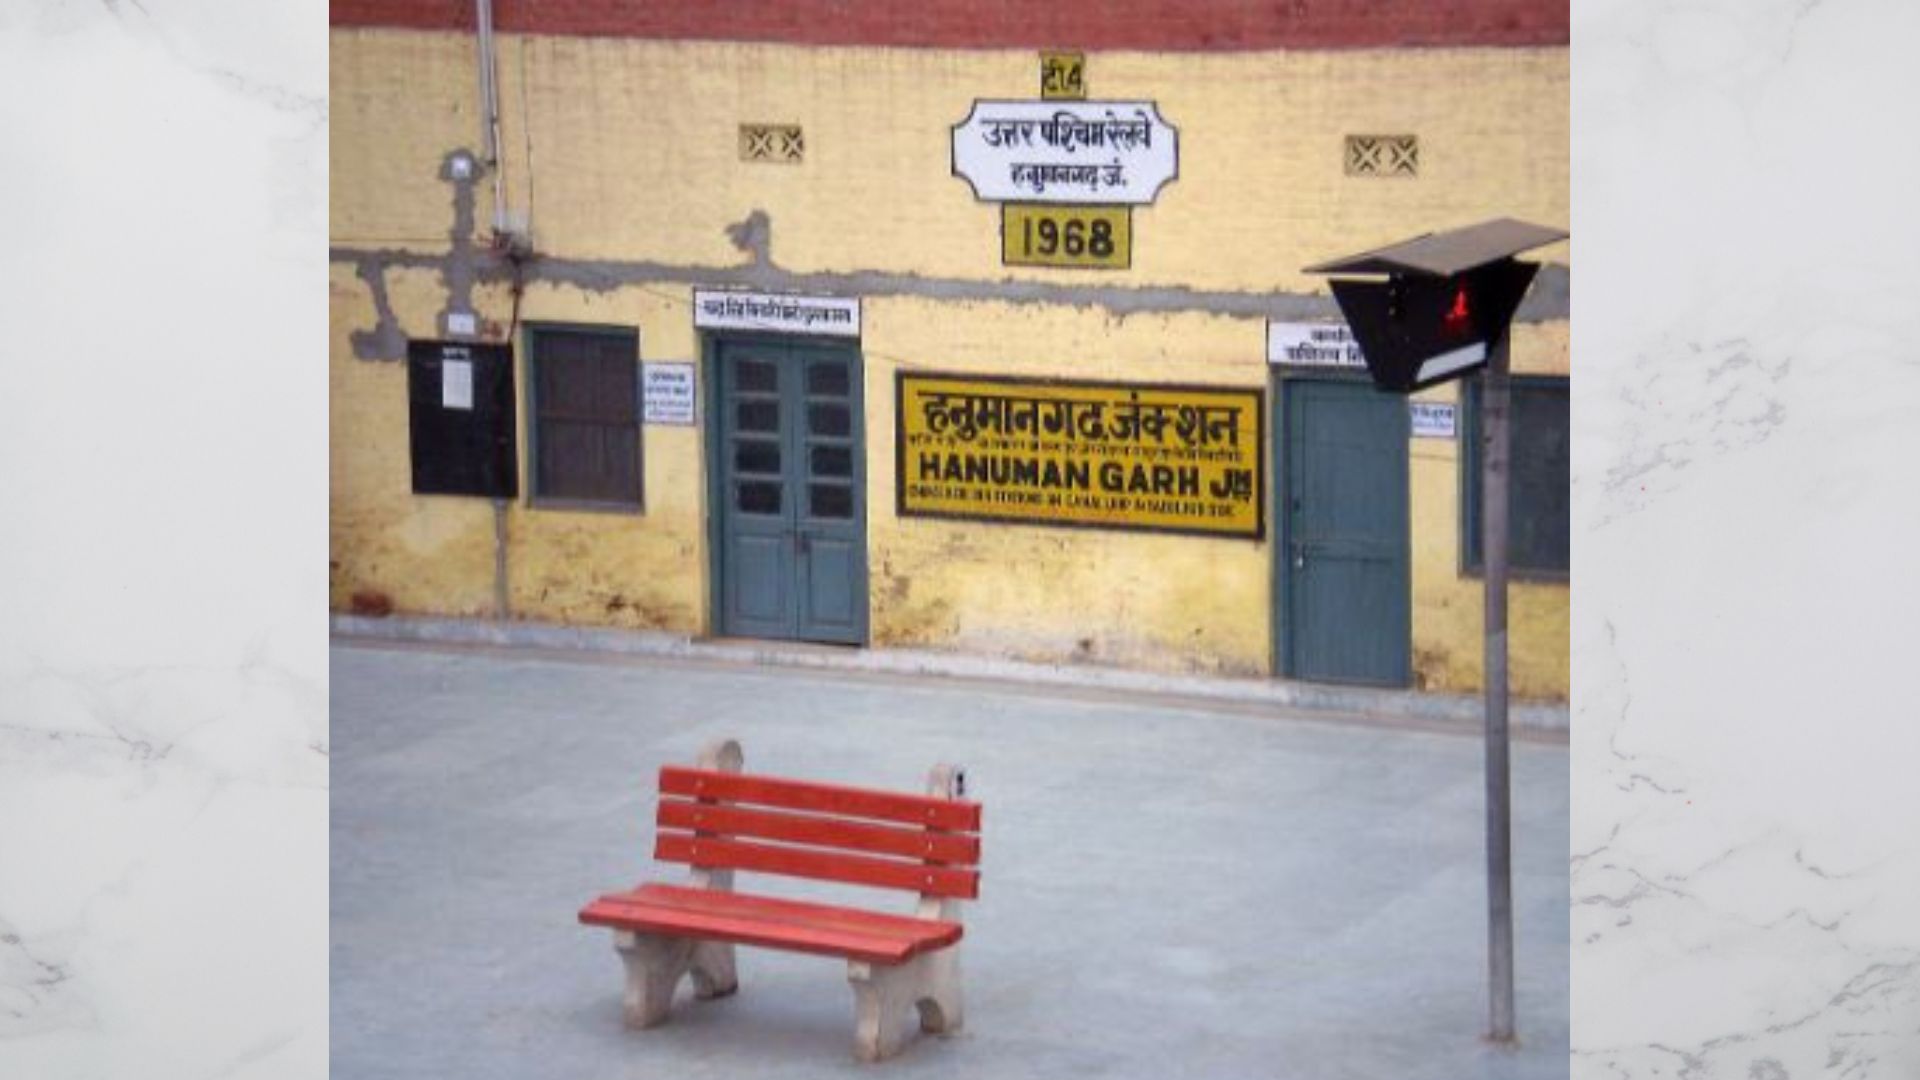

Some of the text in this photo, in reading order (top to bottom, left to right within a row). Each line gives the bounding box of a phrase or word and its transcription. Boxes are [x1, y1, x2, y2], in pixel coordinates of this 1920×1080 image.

[980, 108, 1152, 152] उत्तर पश्चिम रेलवे
[1023, 216, 1114, 257] 1968
[918, 452, 1090, 490] HANUMAN
[1099, 461, 1200, 497] GARH
